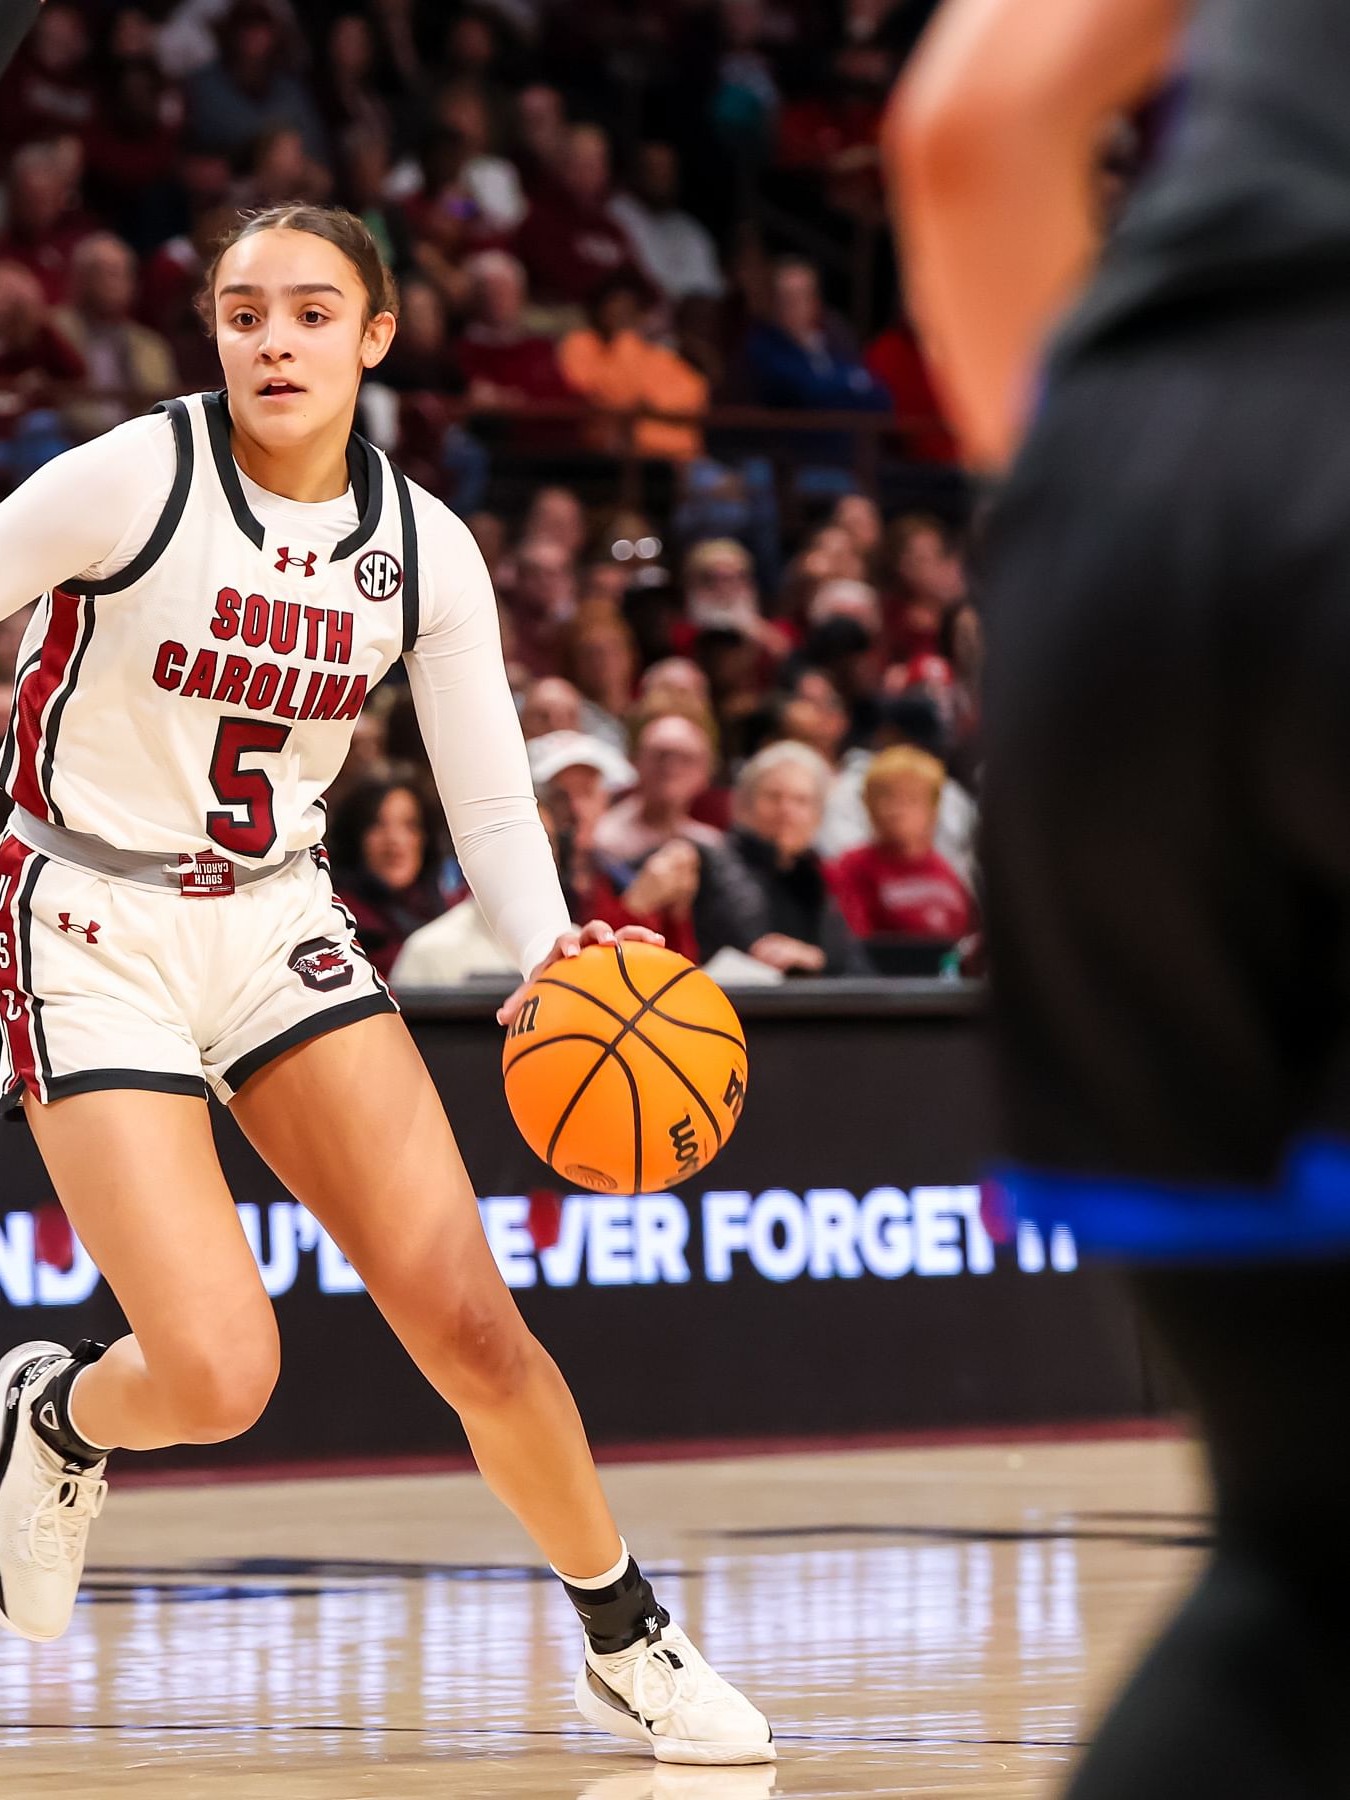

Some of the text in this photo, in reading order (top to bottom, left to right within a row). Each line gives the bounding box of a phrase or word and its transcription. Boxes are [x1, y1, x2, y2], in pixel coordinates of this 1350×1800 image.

[358, 552, 401, 599] SEC
[210, 587, 354, 664] SOUTH
[152, 640, 368, 721] CAROLINA
[206, 716, 292, 859] 5
[194, 862, 229, 874] CAROLIN
[195, 874, 223, 885] SOUTH
[702, 1184, 997, 1282] FORGET
